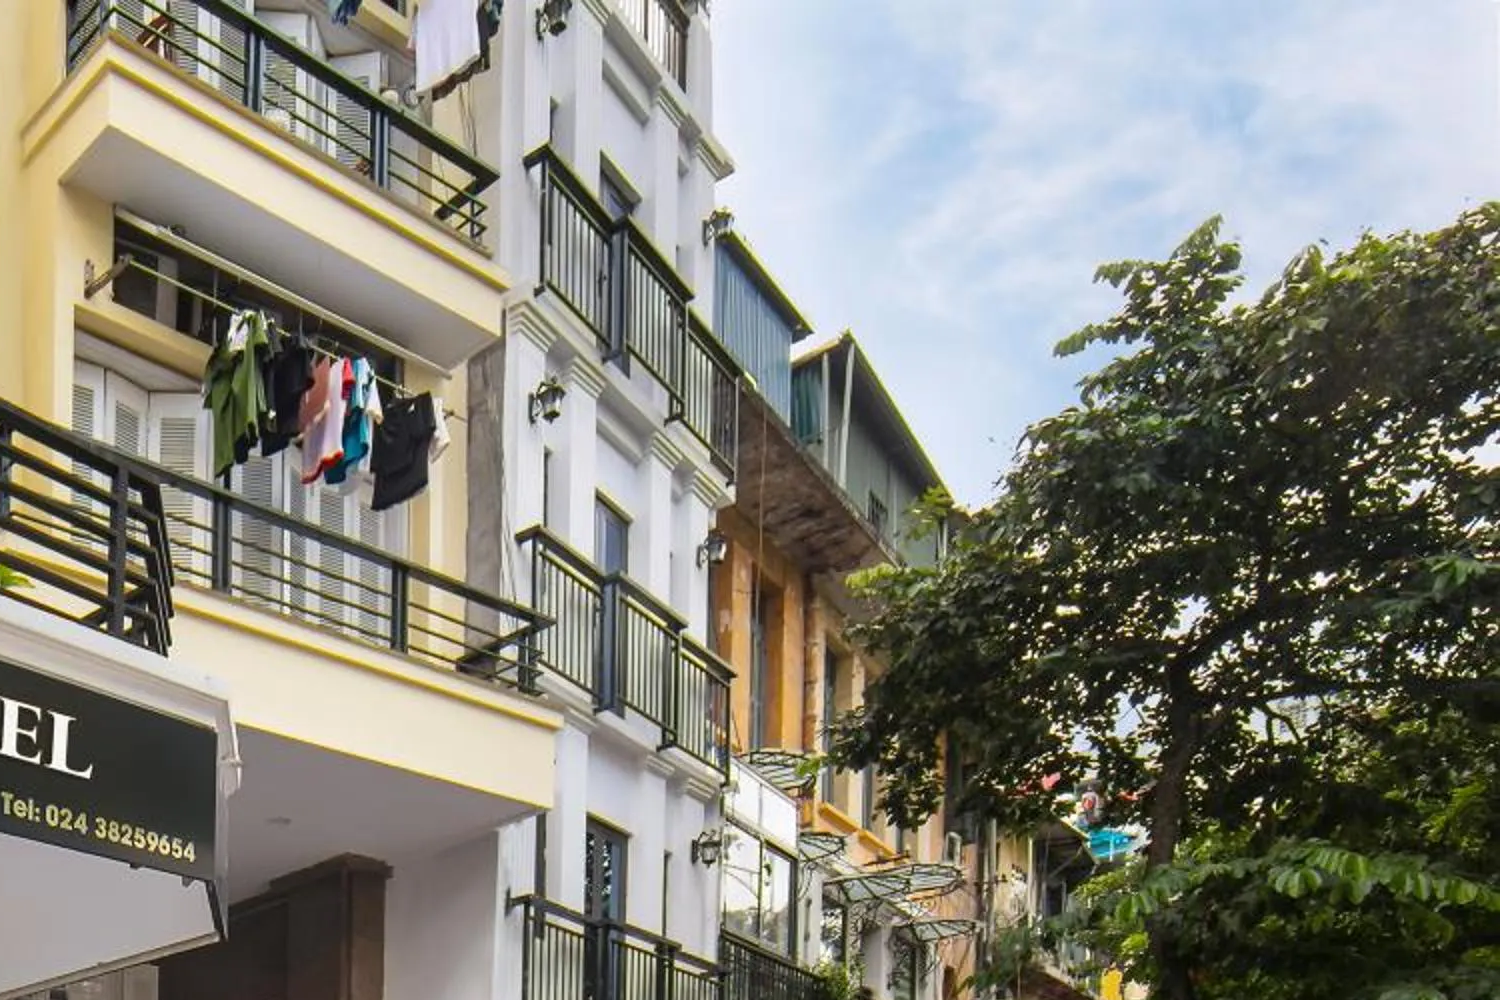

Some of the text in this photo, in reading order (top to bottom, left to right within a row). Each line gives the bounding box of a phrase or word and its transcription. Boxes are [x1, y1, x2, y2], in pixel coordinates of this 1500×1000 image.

[0, 791, 196, 863] Tel: 024 38259654
